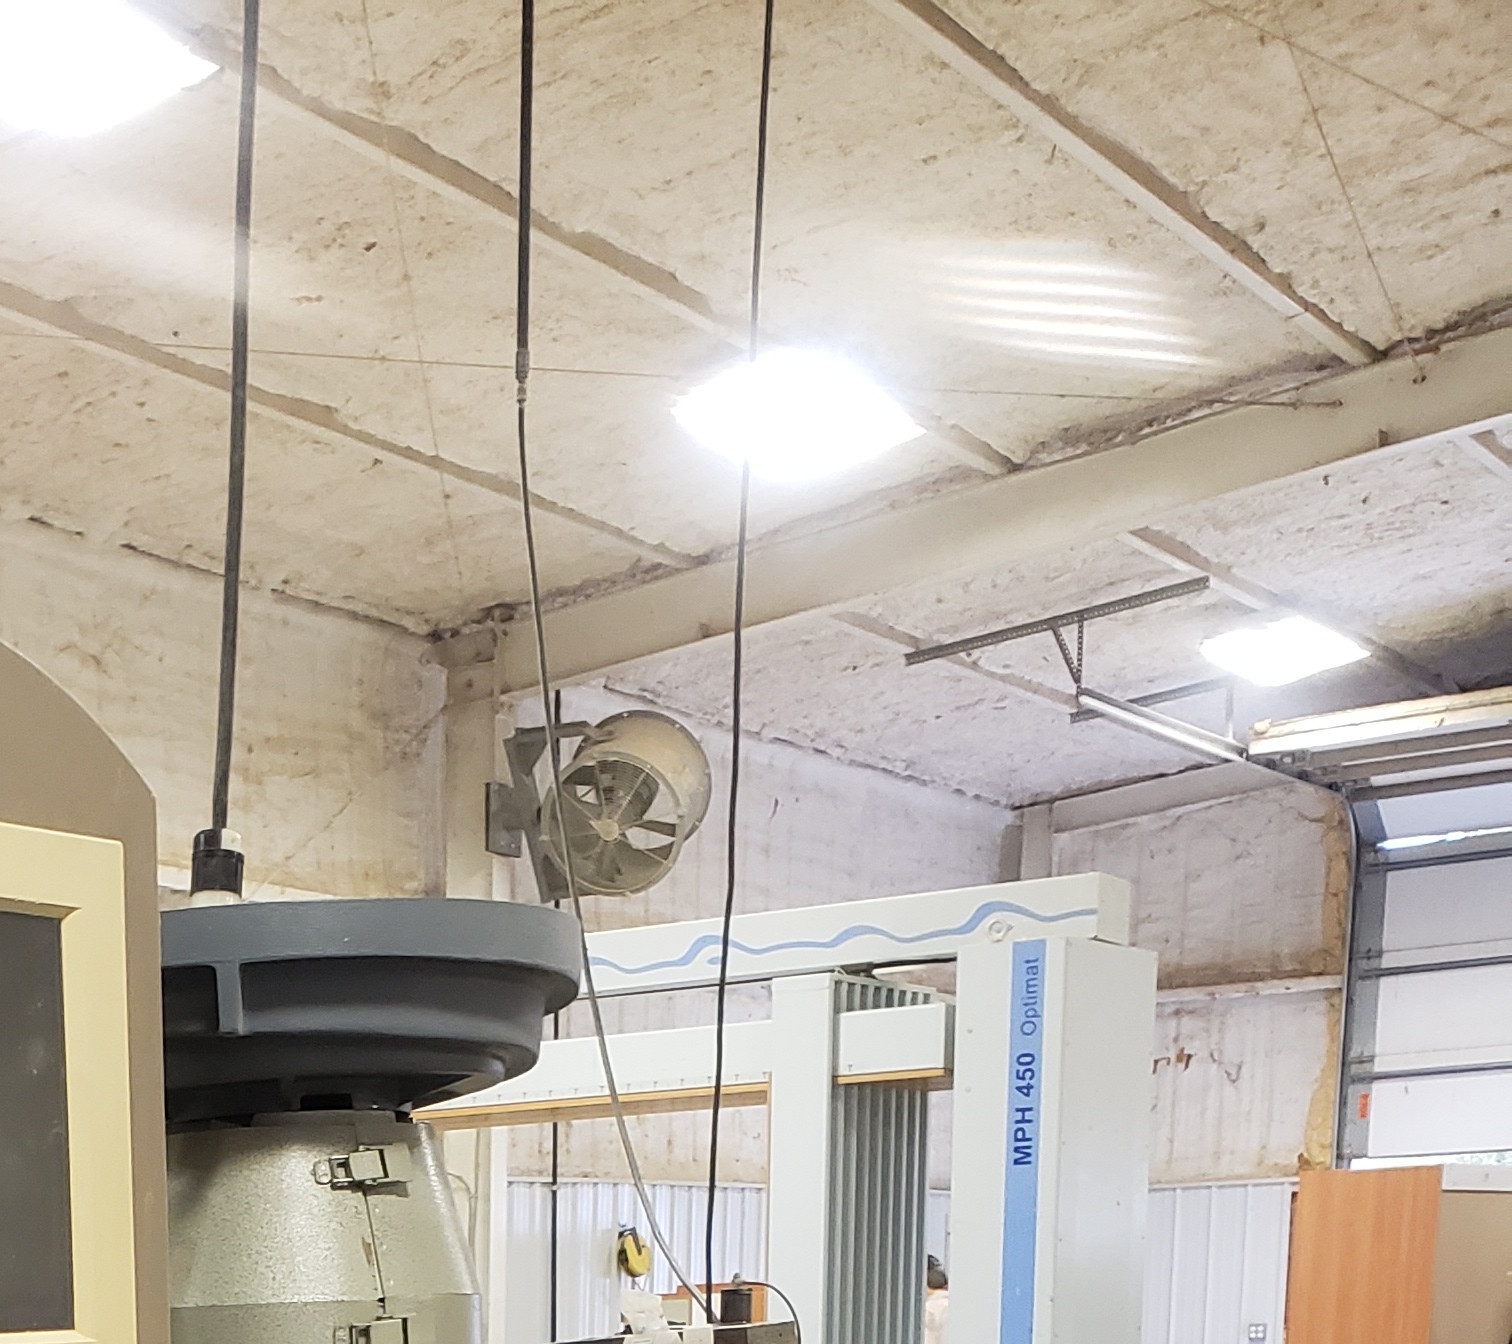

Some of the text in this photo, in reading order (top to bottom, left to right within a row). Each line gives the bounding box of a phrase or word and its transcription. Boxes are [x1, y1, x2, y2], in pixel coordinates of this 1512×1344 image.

[1013, 957, 1042, 1166] MPH 450 Optimat
